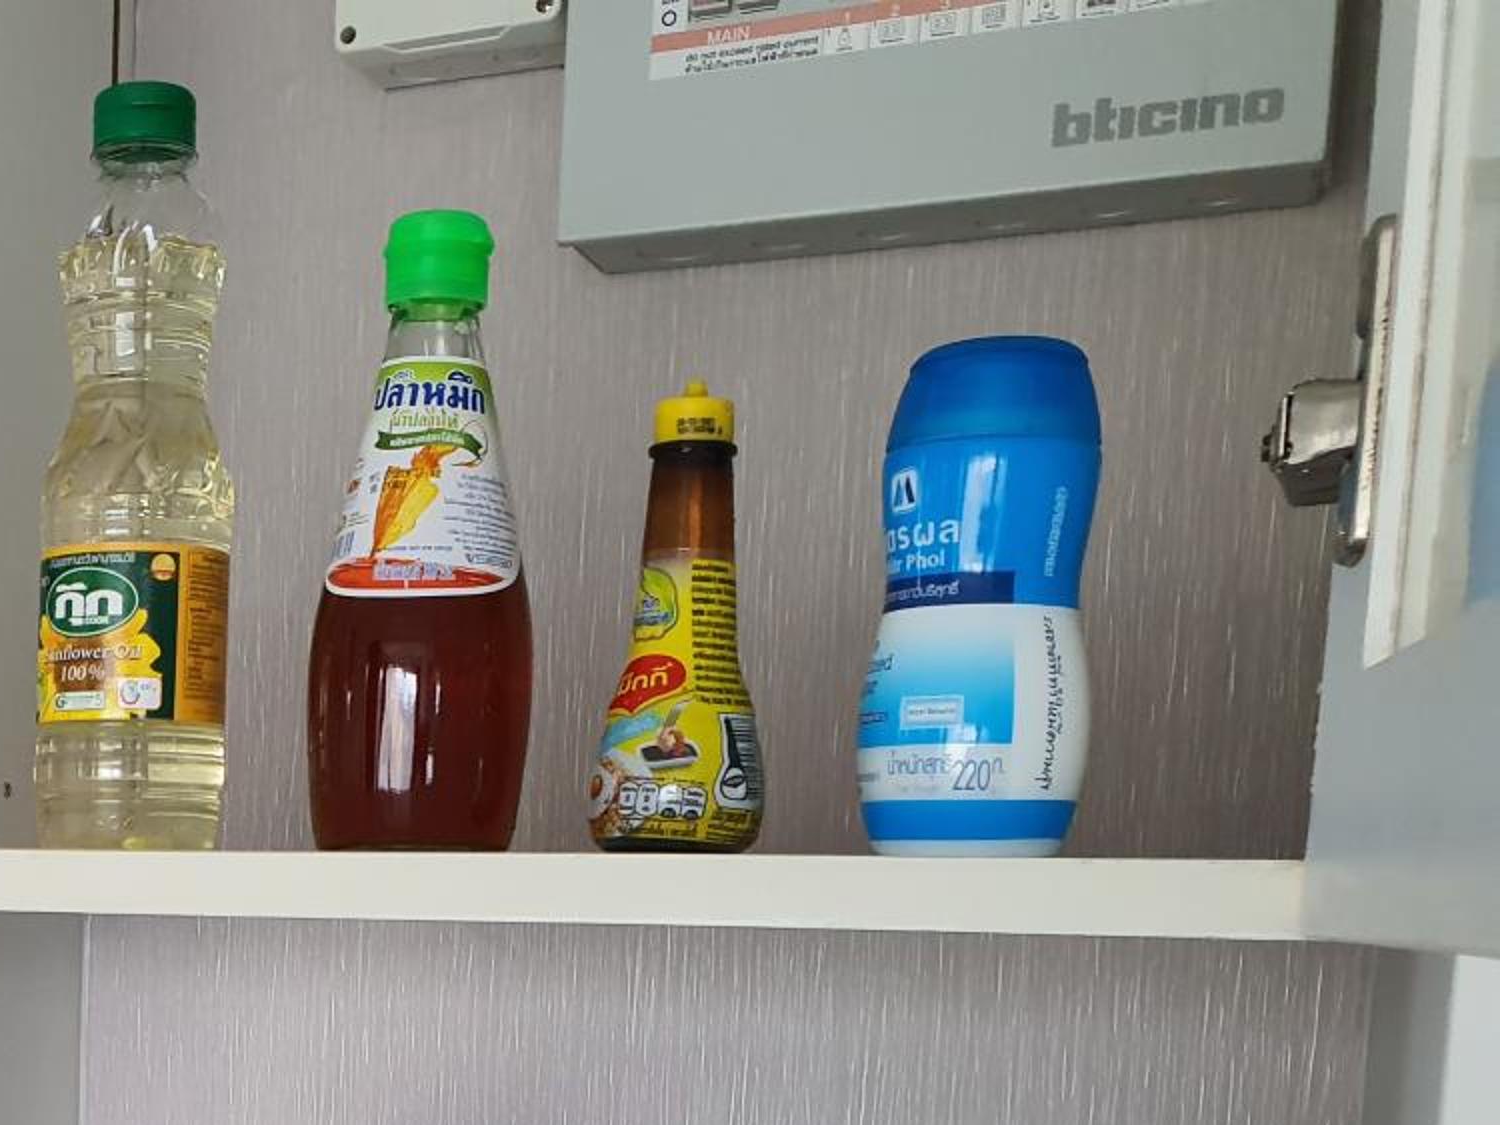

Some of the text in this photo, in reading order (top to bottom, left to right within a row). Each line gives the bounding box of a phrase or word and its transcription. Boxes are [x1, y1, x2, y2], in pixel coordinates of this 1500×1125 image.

[707, 25, 752, 46] MAIN
[1051, 86, 1286, 148] bticino
[373, 371, 486, 415] ปลาหมึก
[905, 547, 946, 572] Phol
[951, 758, 992, 792] 220
